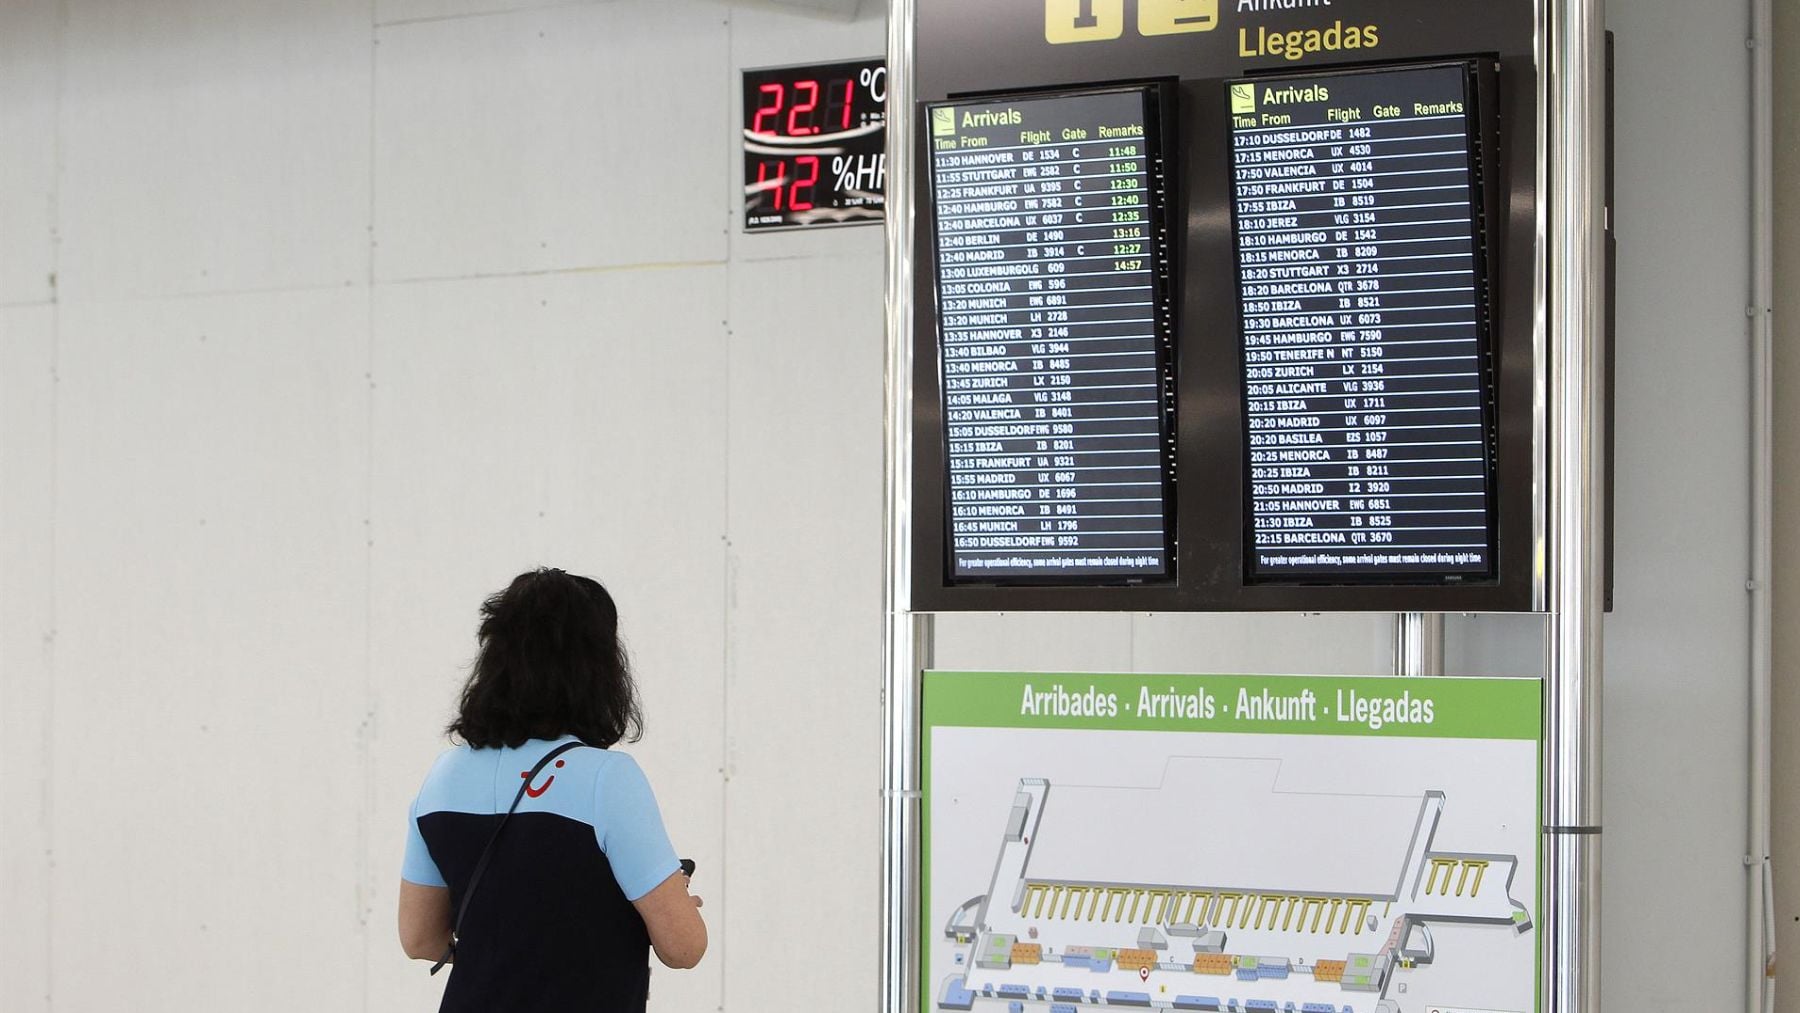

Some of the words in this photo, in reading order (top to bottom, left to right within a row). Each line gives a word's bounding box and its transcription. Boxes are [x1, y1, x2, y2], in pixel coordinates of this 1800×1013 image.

[1239, 20, 1379, 60] Llegadas
[1263, 84, 1329, 105] Arrivals
[753, 79, 854, 136] 22.1
[962, 108, 1021, 127] Arrivals
[1233, 116, 1256, 128] Time
[1262, 114, 1291, 126] From
[1327, 107, 1360, 122] Flight
[1373, 105, 1401, 117] Gate
[1414, 101, 1463, 115] Remarks
[935, 138, 956, 150] Time
[961, 136, 988, 147] From
[1021, 131, 1051, 144] Flight
[1062, 128, 1087, 140] Gate
[1098, 124, 1144, 138] Remarks
[1234, 135, 1261, 146] 17:10
[1330, 129, 1342, 140] DE
[1349, 127, 1371, 138] 1482
[935, 155, 961, 168] 11:30
[961, 152, 1014, 166] HANNOVER
[1072, 147, 1080, 158] C
[1109, 146, 1136, 157] 11:48
[1235, 152, 1262, 163] 17:15
[1263, 148, 1314, 161] MENORCA
[1331, 146, 1343, 157] UX
[1349, 144, 1371, 155] 4530
[936, 172, 961, 184] 11:55
[961, 168, 1017, 182] STUTTGART
[1073, 164, 1081, 174] C
[1110, 162, 1137, 173] 11:50
[1236, 168, 1263, 180] 17:50
[1264, 165, 1316, 178] VALENCIA
[1331, 163, 1344, 174] UX
[1350, 161, 1373, 172] 4014
[758, 156, 819, 211] 42
[936, 188, 962, 200] 12:25
[962, 184, 1019, 198] FRANKFURT
[1074, 180, 1082, 190] C
[1111, 178, 1138, 189] 12:30
[1237, 185, 1264, 196] 17:50
[1265, 181, 1326, 194] FRANKFURT
[1332, 180, 1345, 190] DE
[1352, 178, 1374, 189] 1504
[937, 203, 963, 216] 12:40
[963, 200, 1018, 214] HAMBURGO
[1074, 196, 1082, 206] C
[1112, 195, 1139, 206] 12:40
[1238, 201, 1264, 213] 17:55
[1266, 200, 1296, 211] IBIZA
[1333, 197, 1345, 207] IB
[1352, 195, 1375, 206] 8519
[938, 219, 964, 232] 12:40
[964, 216, 1021, 230] BARCELONA
[1075, 212, 1083, 223] C
[1112, 211, 1139, 222] 12:35
[1238, 218, 1266, 230] 18:10
[1267, 217, 1298, 229] JEREZ
[939, 236, 964, 248] 12:40
[965, 234, 1000, 246] BERLIN
[1113, 227, 1140, 238] 13:16
[1240, 235, 1266, 246] 18:10
[1268, 232, 1327, 245] HAMBURGO
[940, 252, 965, 263] 12:40
[965, 250, 1005, 262] MADRID
[1077, 245, 1084, 255] C
[1114, 244, 1141, 254] 12:27
[1240, 252, 1267, 263] 18:15
[1268, 249, 1320, 261] MENORCA
[941, 267, 966, 279] 13:00
[1115, 260, 1142, 270] 14:57
[1241, 268, 1268, 280] 18:20
[1269, 265, 1329, 278] STUTTGART
[941, 284, 966, 295] 13:05
[967, 281, 1011, 294] COLONIA
[1242, 285, 1269, 296] 18:20
[1270, 282, 1332, 295] BARCELONA
[942, 299, 967, 311] 13:20
[968, 298, 1007, 309] MUNICH
[1243, 302, 1270, 313] 18:50
[1271, 300, 1302, 311] IBIZA
[943, 315, 968, 326] 13:20
[969, 313, 1008, 325] MUNICH
[1244, 318, 1271, 329] 19:30
[1272, 316, 1334, 328] BARCELONA
[944, 331, 969, 342] 13:35
[969, 329, 1022, 341] HANNOVER
[1245, 334, 1272, 345] 19:45
[1273, 332, 1332, 344] HAMBURGO
[945, 347, 970, 358] 13:40
[970, 345, 1006, 357] BILBAO
[1246, 351, 1273, 362] 19:50
[1273, 349, 1324, 360] TENERIFE
[1326, 348, 1335, 359] N
[945, 362, 970, 374] 13:40
[971, 361, 1018, 372] MENORCA
[1247, 368, 1273, 378] 20:05
[1275, 366, 1314, 377] ZURICH
[946, 378, 971, 389] 13:45
[972, 377, 1008, 388] ZURICH
[1247, 384, 1274, 395] 20:05
[1276, 382, 1327, 394] ALICANTE
[947, 394, 972, 405] 14:05
[972, 393, 1012, 404] MALAGA
[1248, 401, 1275, 412] 20:15
[1276, 400, 1307, 411] IBIZA
[948, 410, 973, 421] 14:20
[973, 409, 1021, 420] VALENCIA
[1249, 418, 1276, 428] 20:20
[1277, 417, 1320, 427] MADRID
[949, 426, 973, 437] 15:05
[1250, 434, 1277, 445] 20:20
[1278, 433, 1323, 444] BASILEA
[949, 442, 974, 453] 15:15
[975, 442, 1003, 452] IBIZA
[1251, 451, 1278, 462] 20:25
[1279, 450, 1330, 461] MENORCA
[950, 458, 975, 469] 15:15
[976, 457, 1032, 468] FRANKFURT
[951, 474, 976, 485] 15:55
[977, 473, 1016, 484] MADRID
[1252, 468, 1279, 478] 20:25
[1280, 467, 1311, 477] IBIZA
[952, 490, 977, 500] 16:10
[977, 489, 1032, 500] HAMBURGO
[1253, 484, 1280, 495] 20:50
[1281, 483, 1324, 494] MADRID
[953, 506, 978, 516] 16:10
[978, 505, 1025, 516] MENORCA
[1254, 501, 1280, 511] 21:05
[1282, 500, 1340, 511] HANNOVER
[953, 522, 978, 532] 16:45
[979, 521, 1018, 532] MUNICH
[1254, 517, 1282, 528] 21:30
[1283, 517, 1313, 527] IBIZA
[954, 537, 979, 548] 16:50
[1255, 533, 1282, 544] 22:15
[1284, 533, 1346, 543] BARCELONA
[1020, 684, 1118, 717] Arribades
[1136, 686, 1216, 720] Arrivals
[1235, 687, 1316, 721] Ankunft
[1336, 689, 1434, 730] Llegadas
